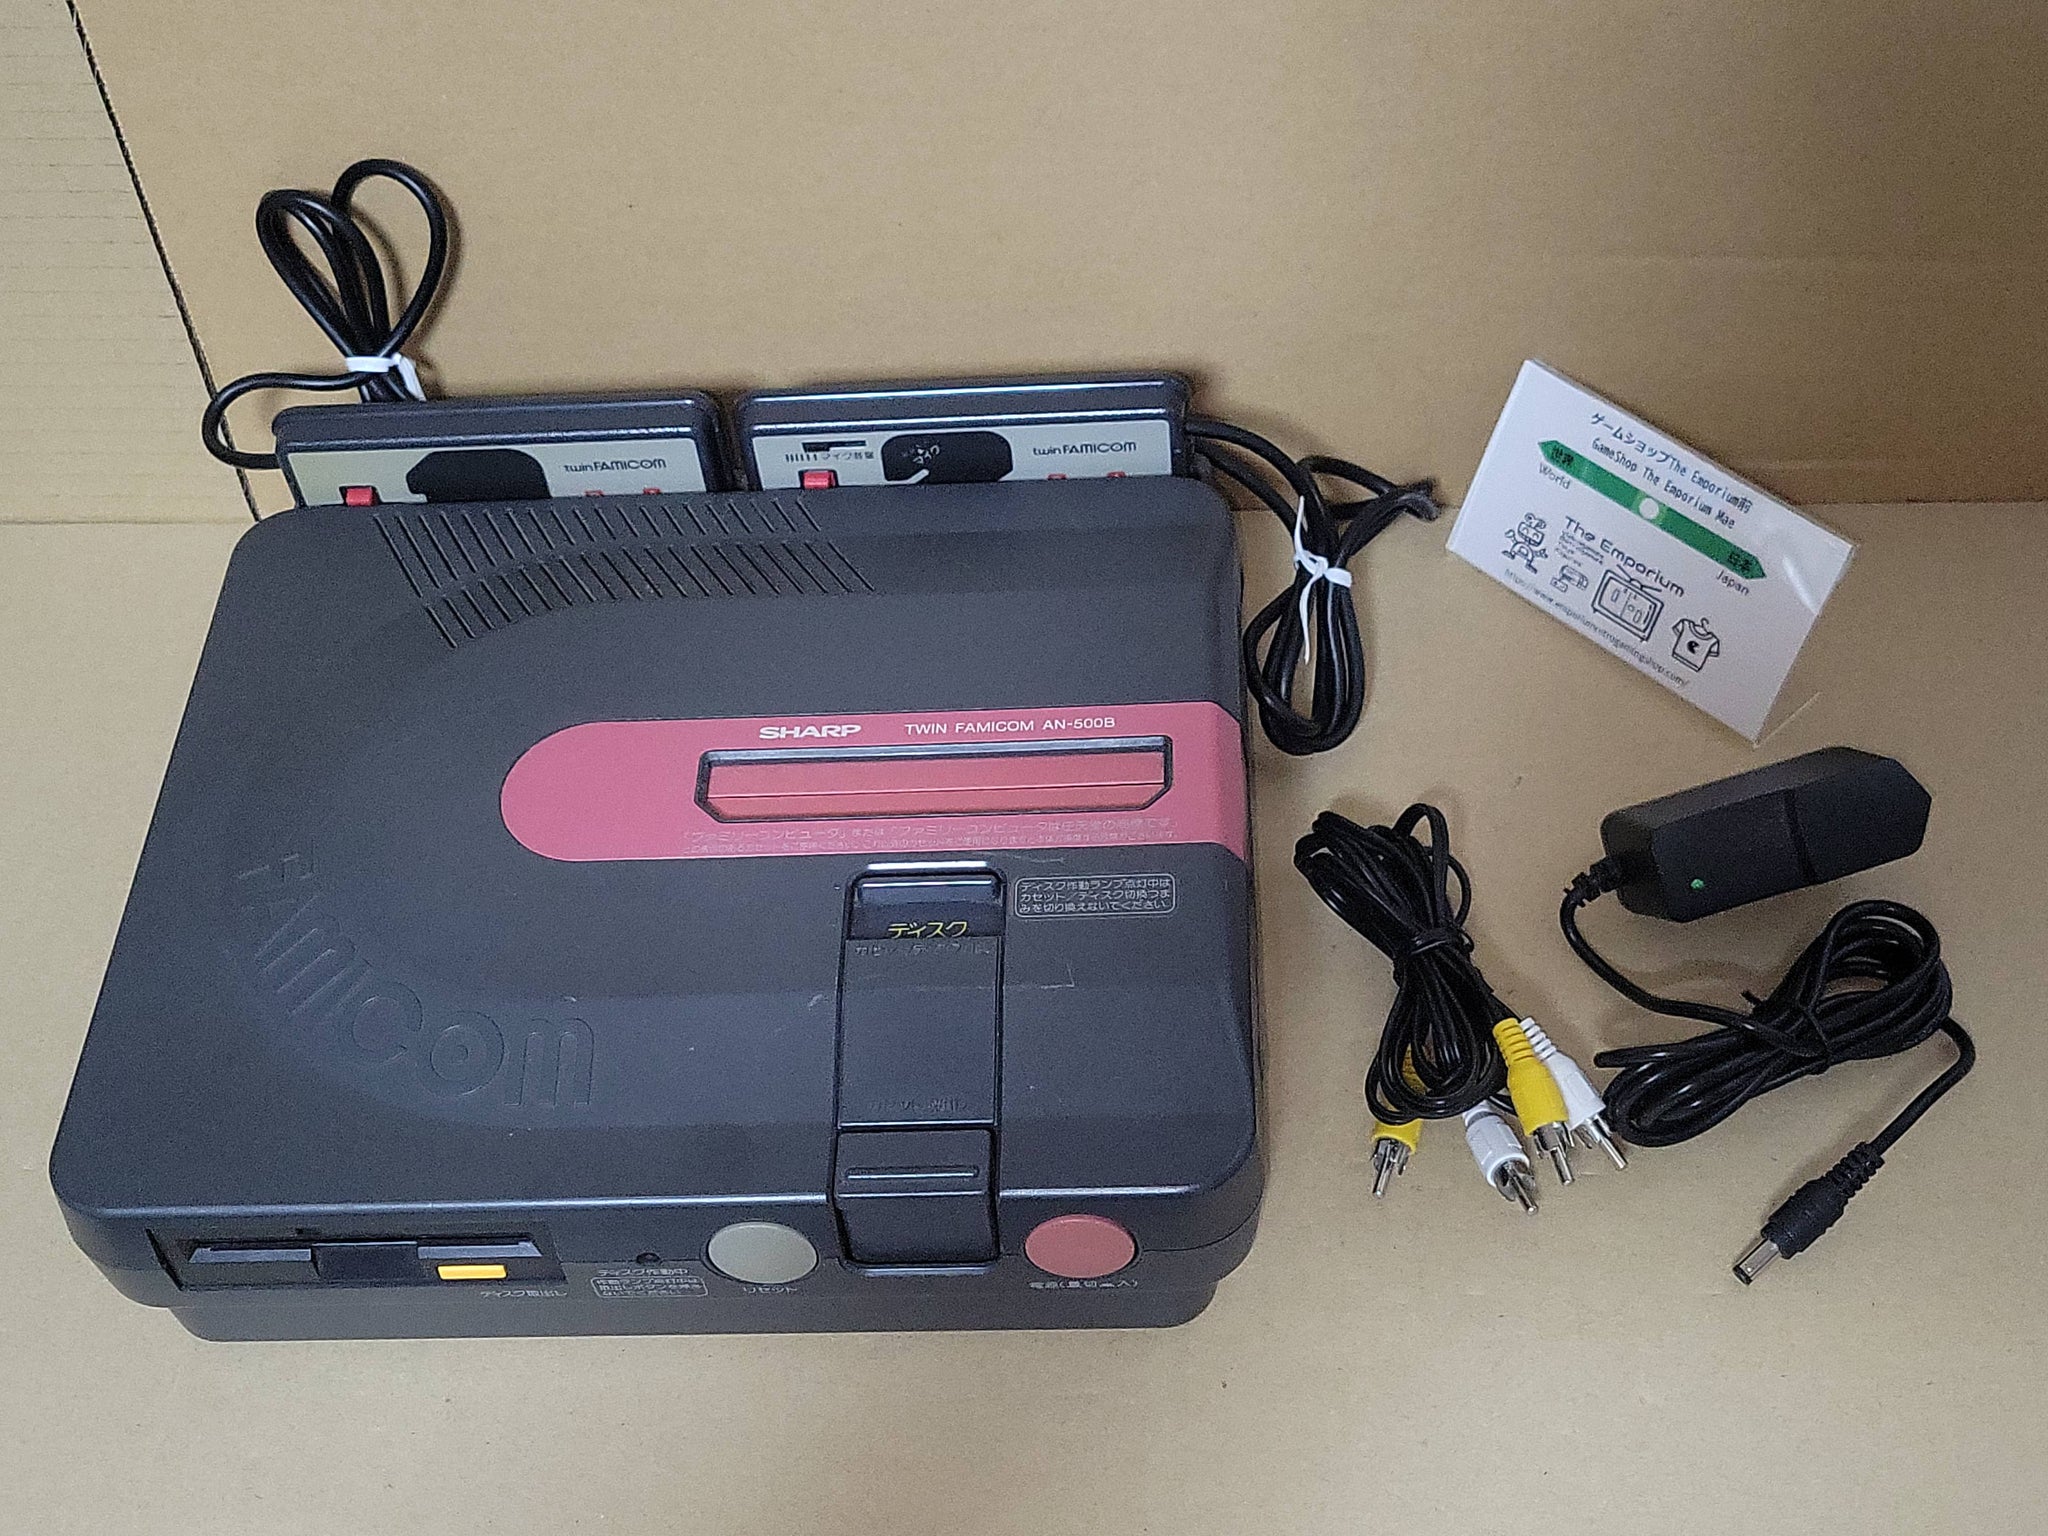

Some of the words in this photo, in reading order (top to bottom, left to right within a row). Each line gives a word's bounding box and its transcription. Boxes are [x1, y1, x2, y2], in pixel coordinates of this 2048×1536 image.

[1538, 463, 1571, 489] World
[1592, 438, 1638, 472] GameShop
[1642, 466, 1660, 486] The
[1664, 479, 1713, 515] Emporium
[1564, 516, 1596, 542] The
[1600, 538, 1685, 598] Emporium
[1715, 569, 1750, 597] Japan
[759, 724, 861, 740] SHARP
[905, 723, 948, 735] TWIN
[955, 720, 1036, 734] FAMICOM
[1042, 717, 1115, 731] AN-500B
[888, 920, 968, 939] ディスク
